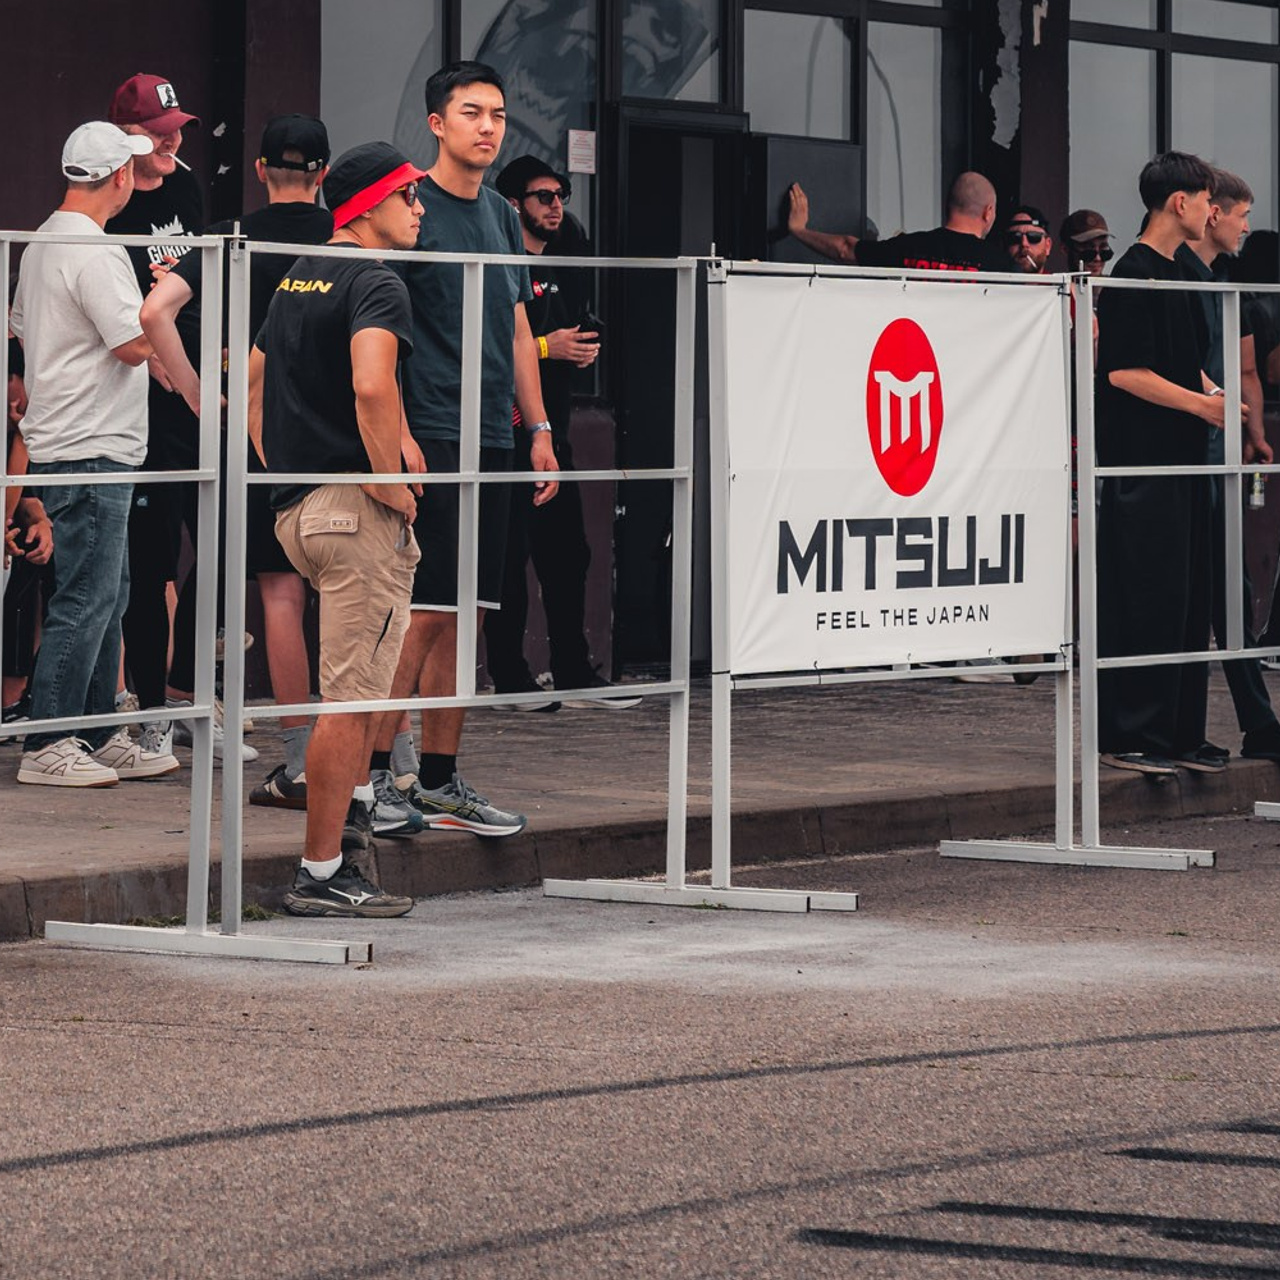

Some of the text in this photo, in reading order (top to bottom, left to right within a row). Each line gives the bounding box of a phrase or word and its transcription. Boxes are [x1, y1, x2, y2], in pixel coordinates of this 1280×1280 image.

[777, 513, 1025, 595] MITSUJI
[816, 604, 989, 631] FEEL THE JAPAN
